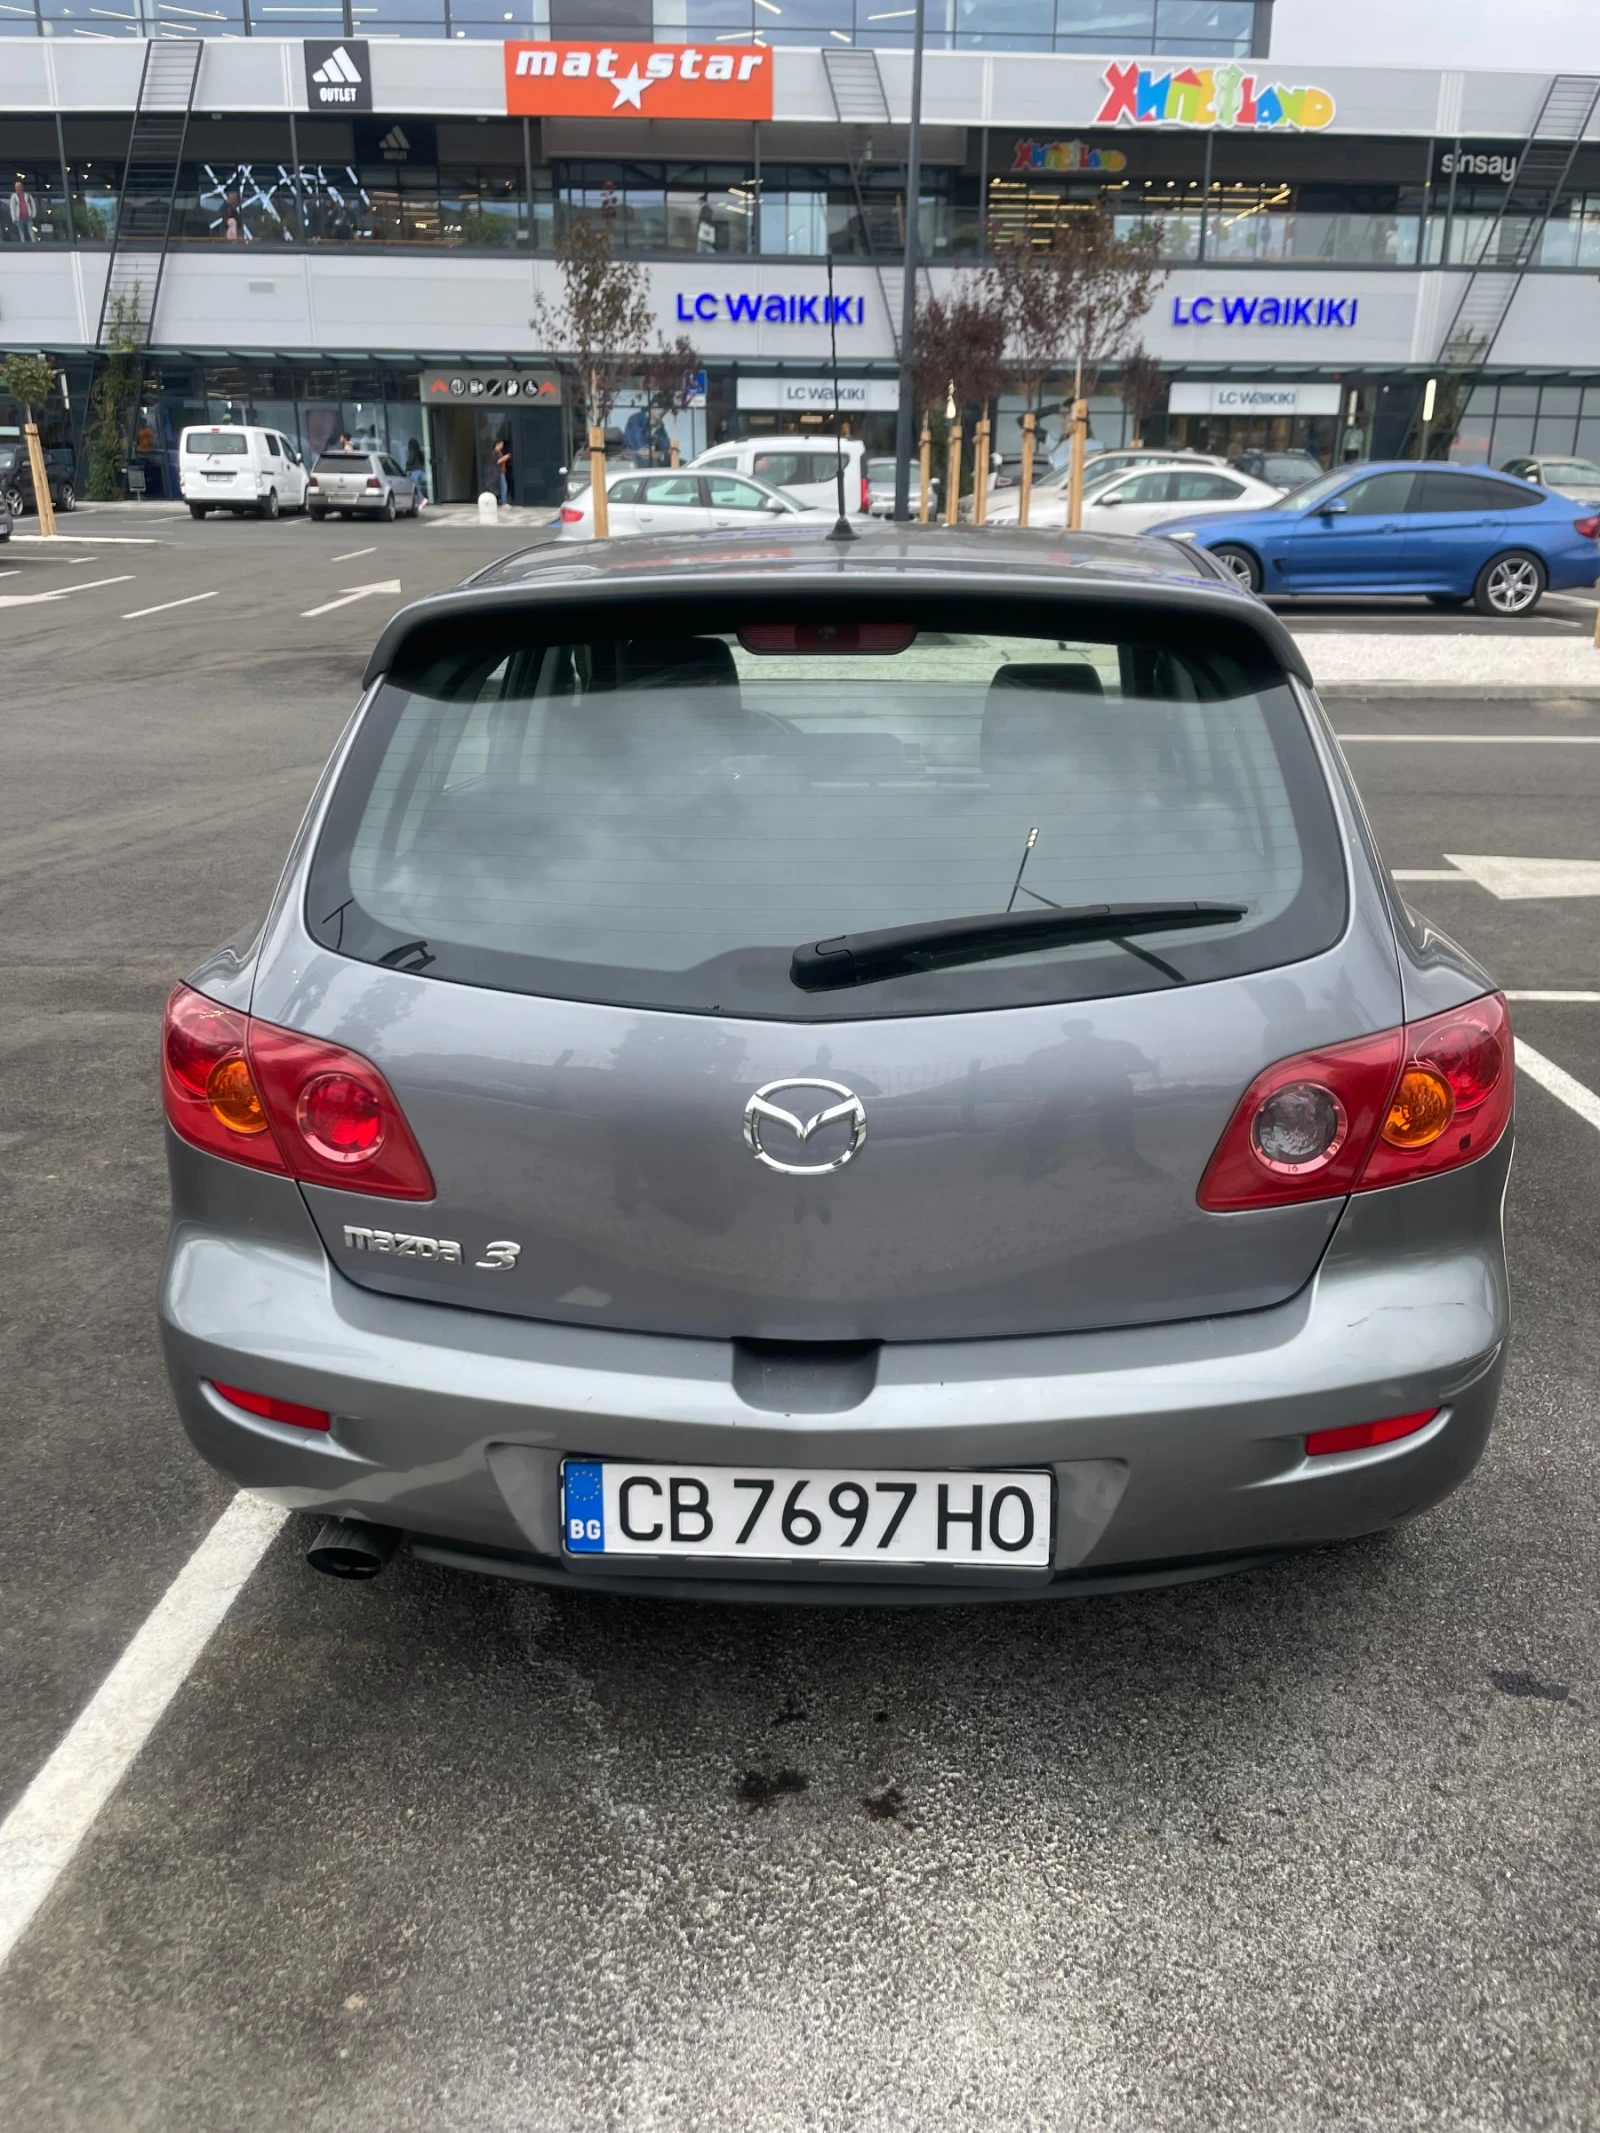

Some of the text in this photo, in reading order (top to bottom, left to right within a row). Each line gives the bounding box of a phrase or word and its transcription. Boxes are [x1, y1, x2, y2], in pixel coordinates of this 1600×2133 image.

[515, 48, 763, 81] mat star
[319, 87, 357, 102] OUTLET
[676, 293, 718, 322] LC
[1172, 296, 1214, 325] LC
[787, 386, 865, 400] LC WaKIKI
[1218, 391, 1237, 404] LC
[343, 1225, 521, 1270] mazda 3
[619, 1476, 713, 1543] CB
[733, 1478, 918, 1548] 7697
[570, 1518, 601, 1540] BG
